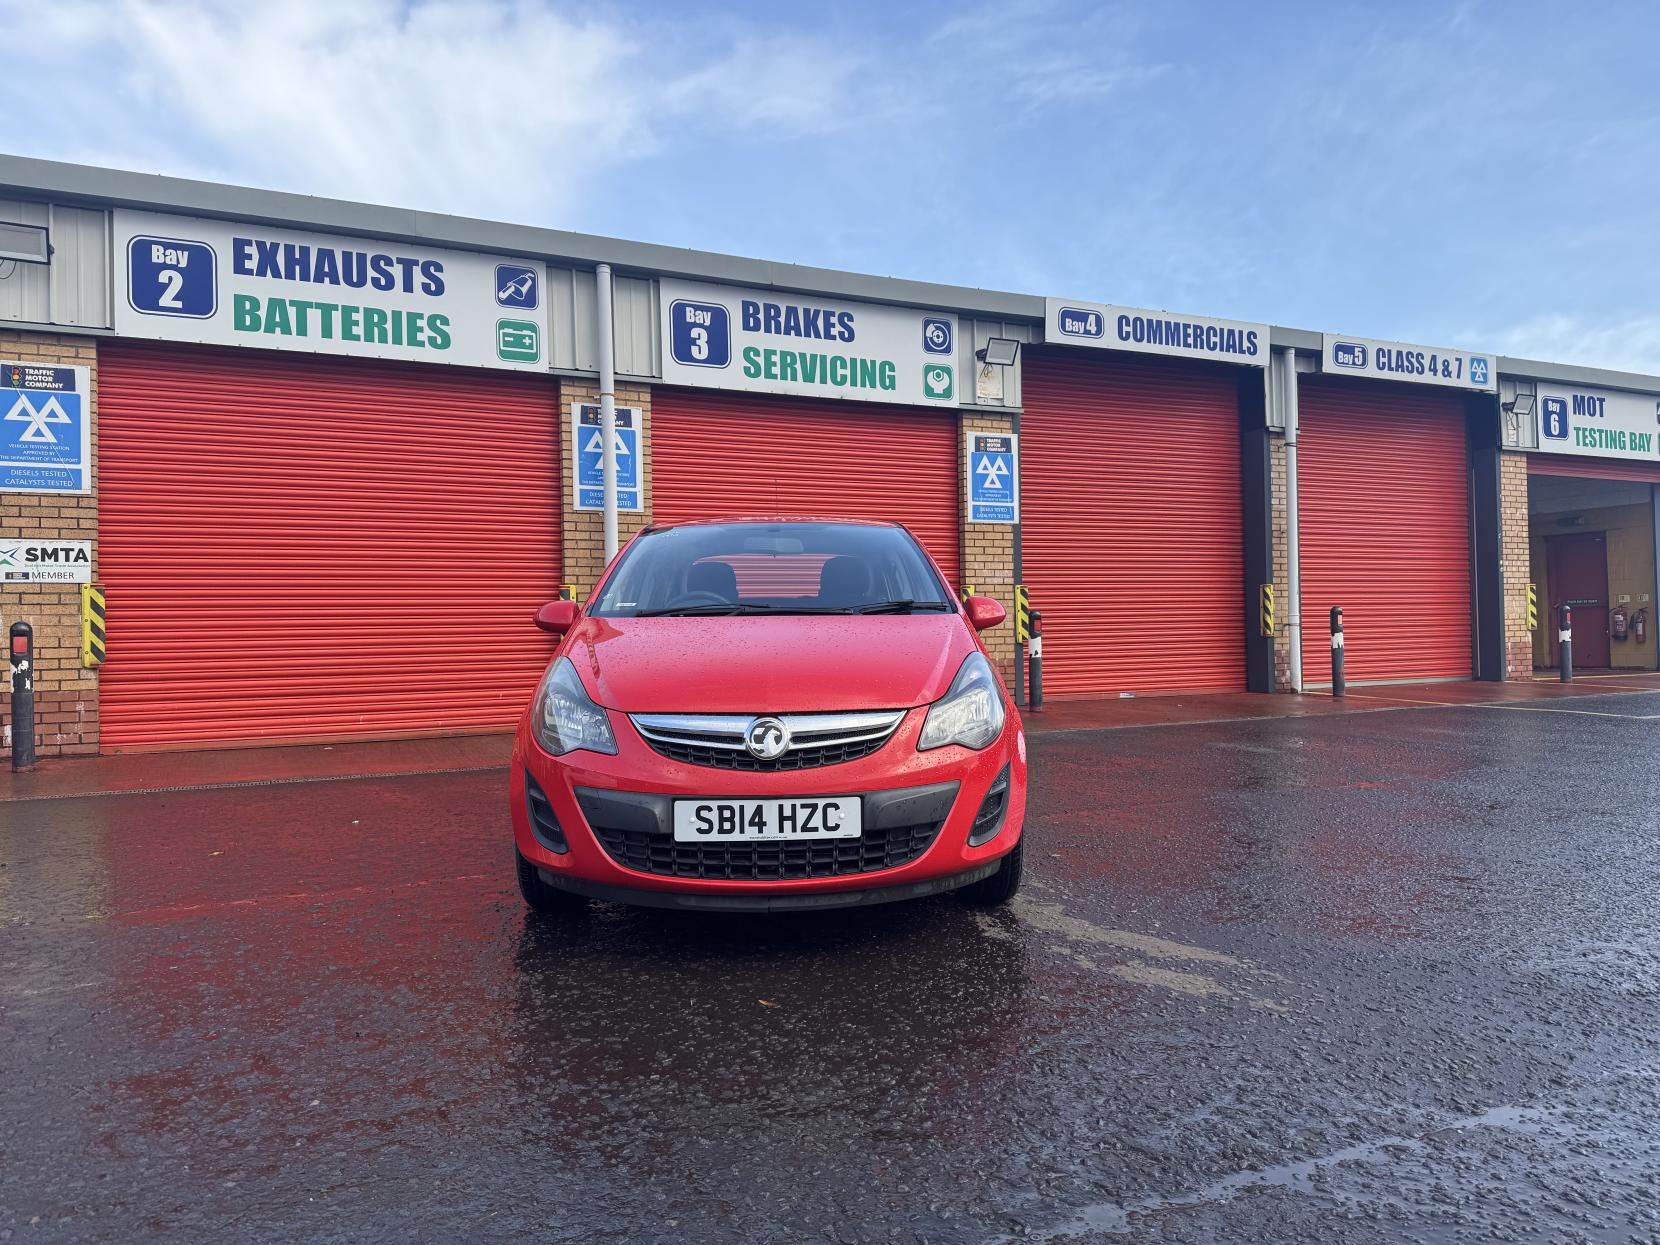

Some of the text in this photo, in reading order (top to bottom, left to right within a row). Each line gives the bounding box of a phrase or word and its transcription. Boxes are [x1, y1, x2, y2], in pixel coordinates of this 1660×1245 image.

[151, 244, 189, 268] Bay
[232, 236, 445, 297] EXHAUSTS
[158, 269, 183, 309] 2
[233, 293, 451, 350] BATTERIES
[685, 306, 712, 327] Bay
[741, 299, 856, 343] BRAKES
[1065, 314, 1097, 335] Bay 4
[690, 327, 709, 360] 3
[1117, 314, 1258, 356] COMMERCIALS
[1337, 347, 1363, 365] Bay 5
[1375, 347, 1463, 379] CLASS 4 & 7
[24, 368, 55, 376] TRAFFIC
[742, 346, 896, 391] SERVICING
[25, 381, 64, 389] COMPANY
[1548, 400, 1560, 413] Bay
[1572, 394, 1606, 418] MOT
[1550, 413, 1560, 436] 6
[1573, 426, 1652, 453] TESTING BAY
[5, 478, 73, 487] CATALYSTS TESTED
[10, 469, 67, 478] DIESELS TESTED
[24, 546, 90, 563] SMTA
[31, 571, 75, 580] MEMBER
[695, 802, 841, 835] SB14 HZC
